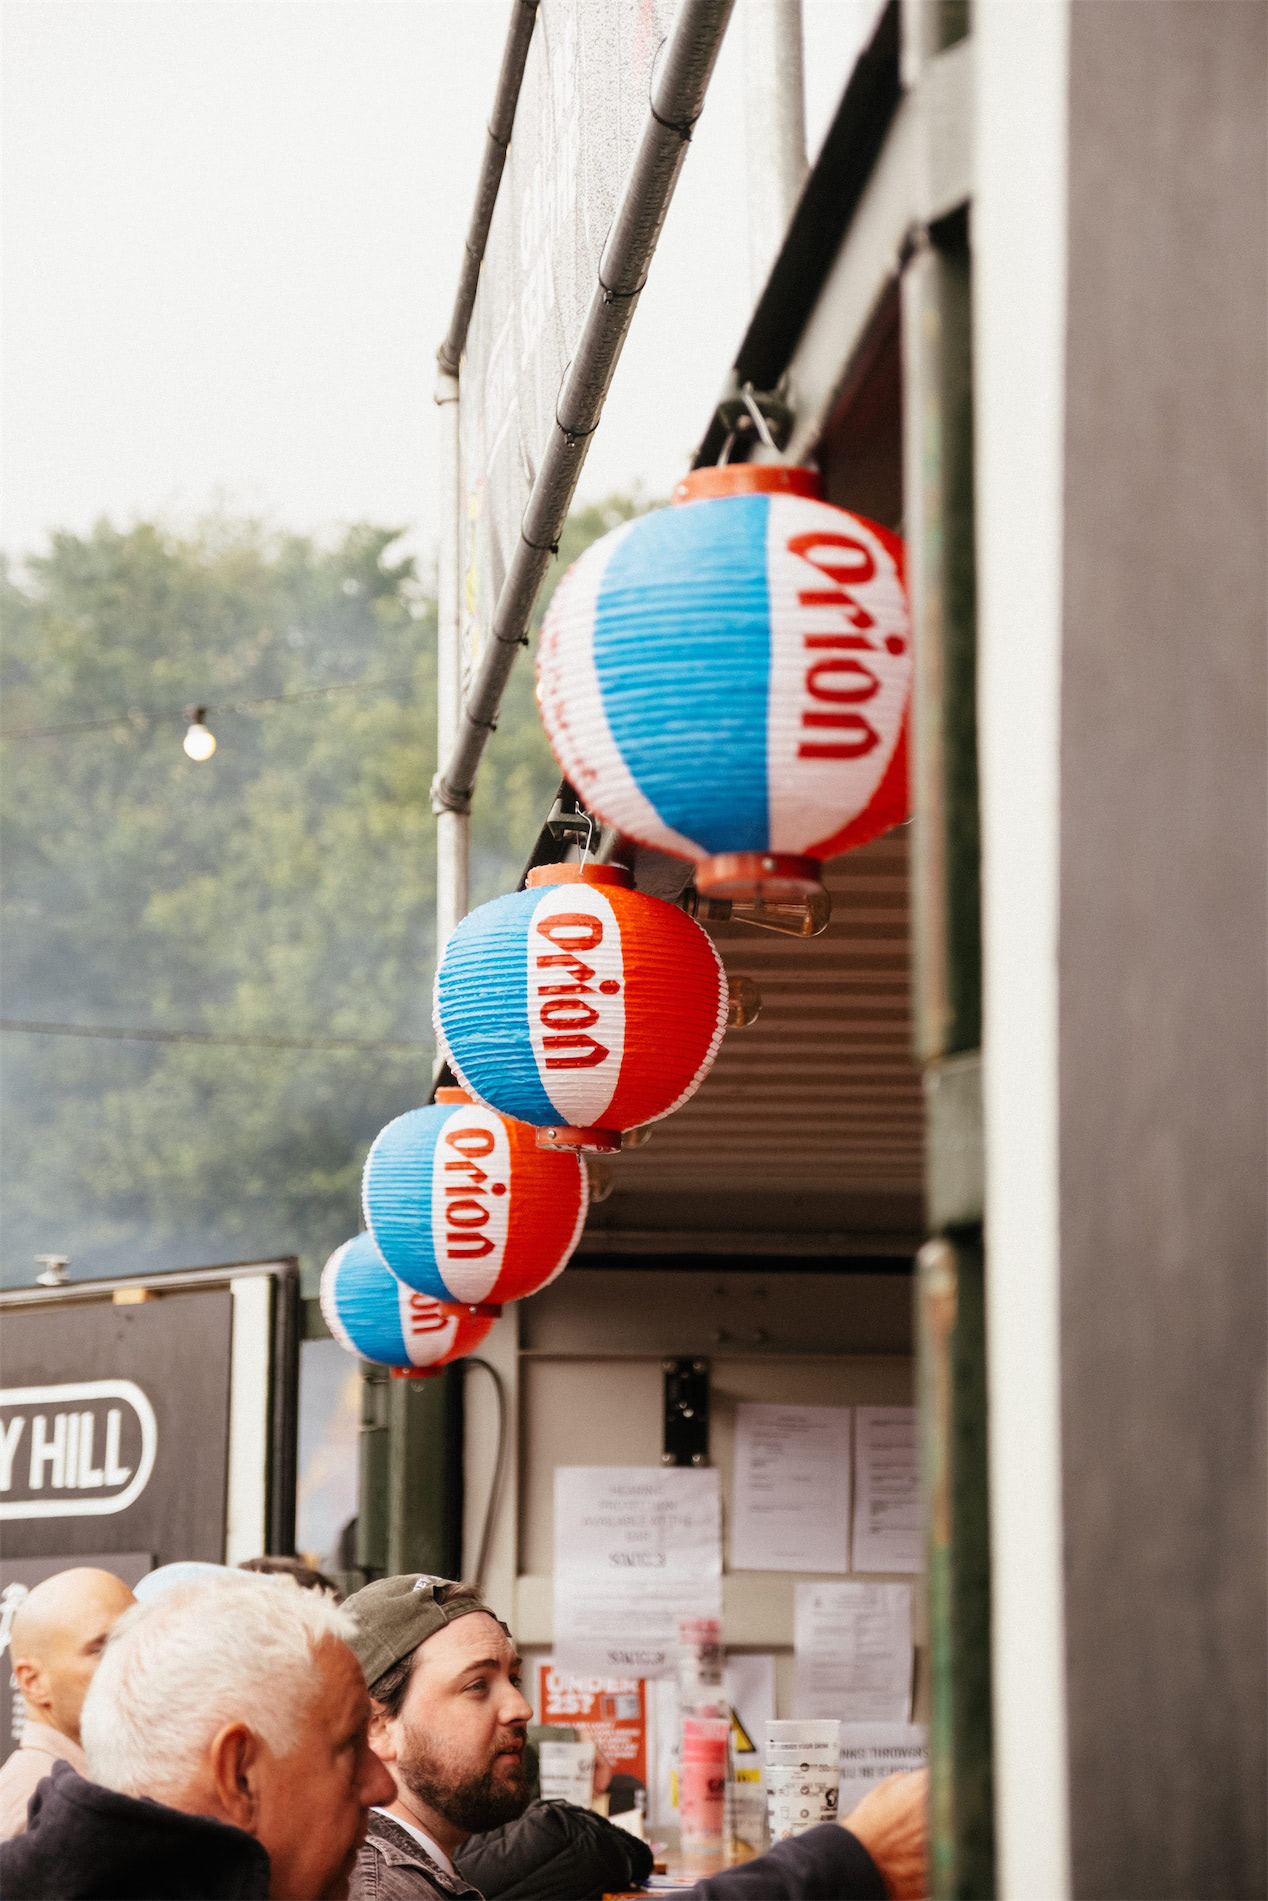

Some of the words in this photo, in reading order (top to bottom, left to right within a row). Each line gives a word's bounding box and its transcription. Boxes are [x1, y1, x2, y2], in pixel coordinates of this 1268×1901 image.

[787, 530, 905, 760] Orion
[536, 912, 621, 1070] Orion
[444, 1127, 507, 1259] Orion
[29, 1409, 132, 1490] HILL
